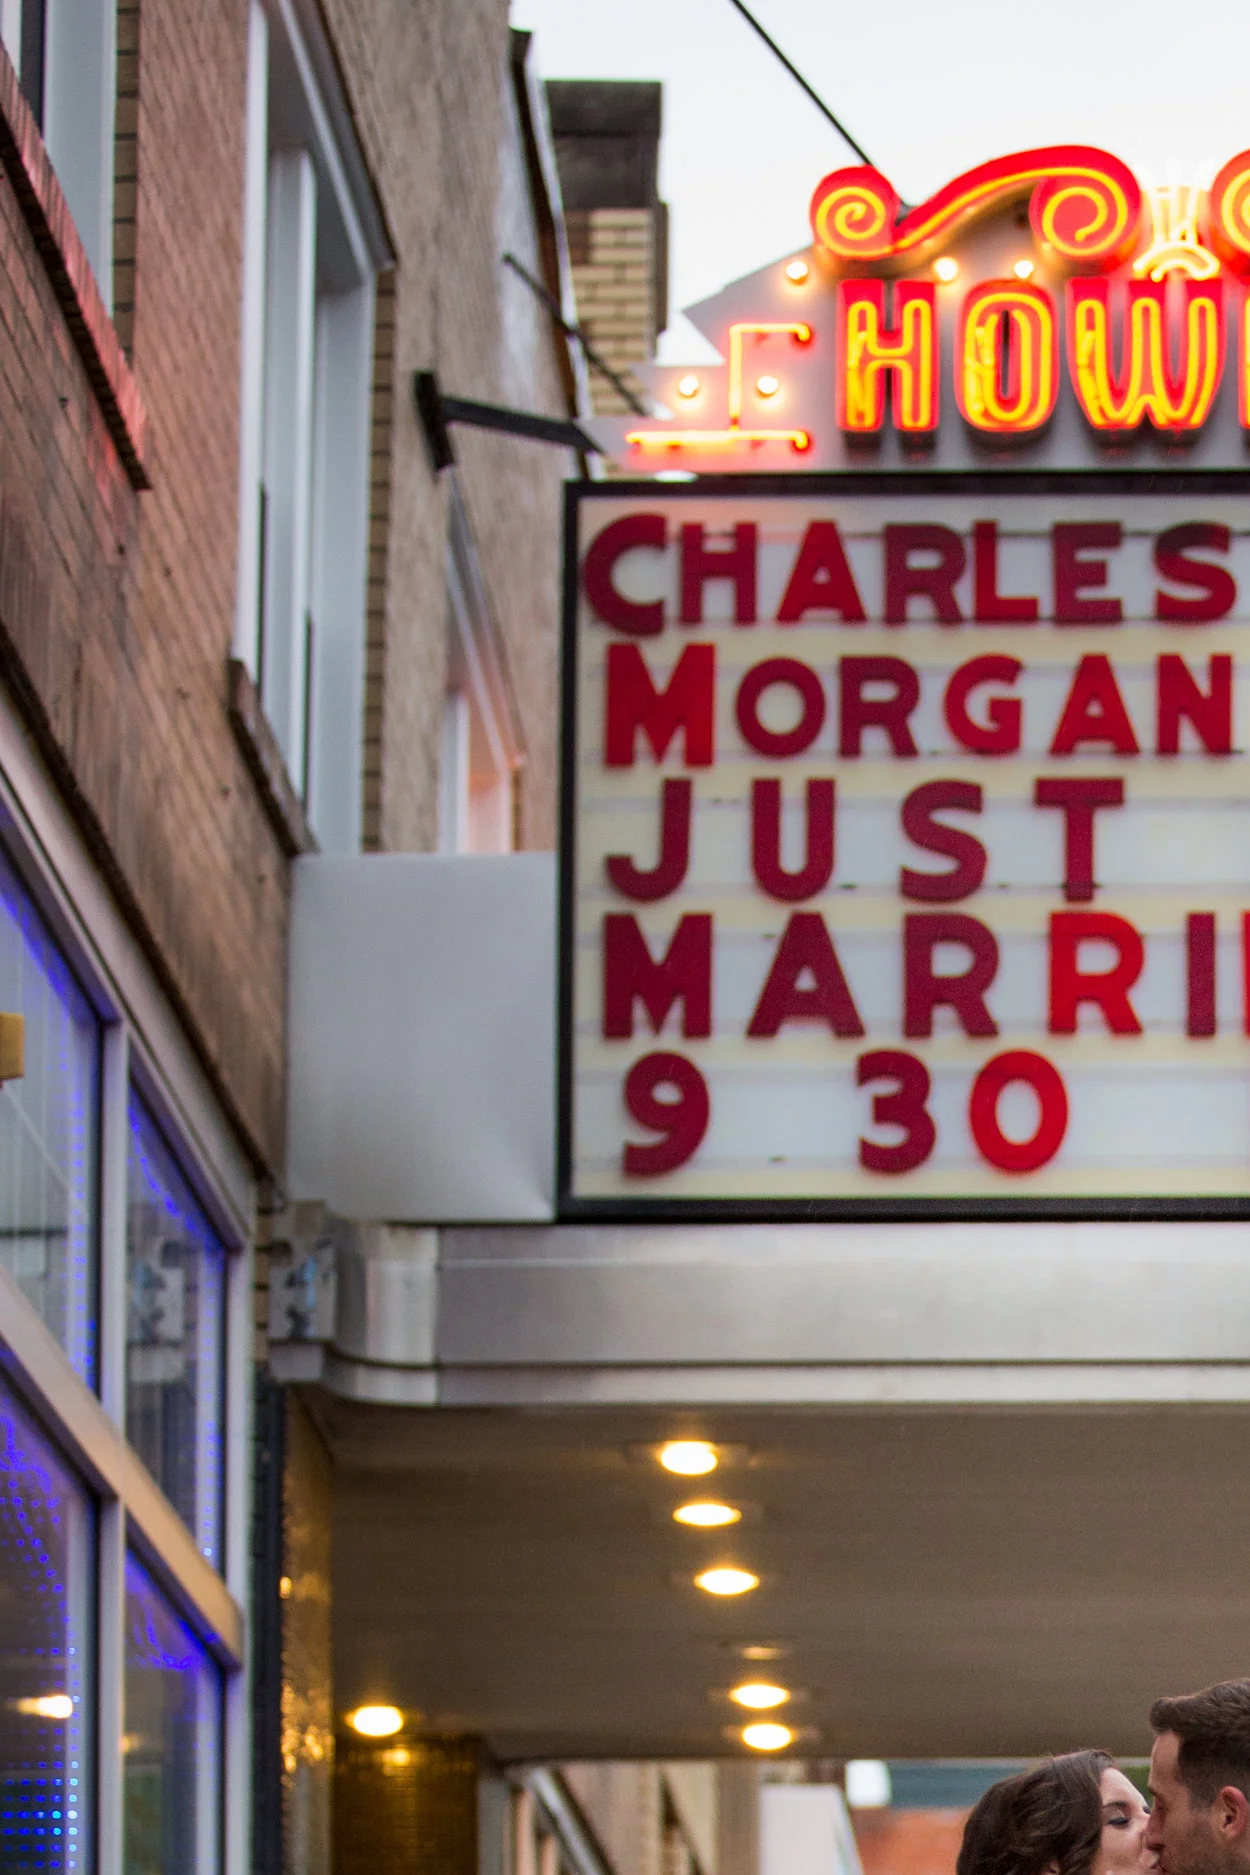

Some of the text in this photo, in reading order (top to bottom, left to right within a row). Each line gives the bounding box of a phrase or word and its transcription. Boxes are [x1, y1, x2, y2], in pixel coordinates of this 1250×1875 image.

[583, 512, 1238, 636] CHARLES
[603, 641, 1235, 768] MORGAN
[606, 777, 1126, 905] JUST
[622, 1050, 711, 1178] 9
[856, 1049, 1069, 1177] 30
